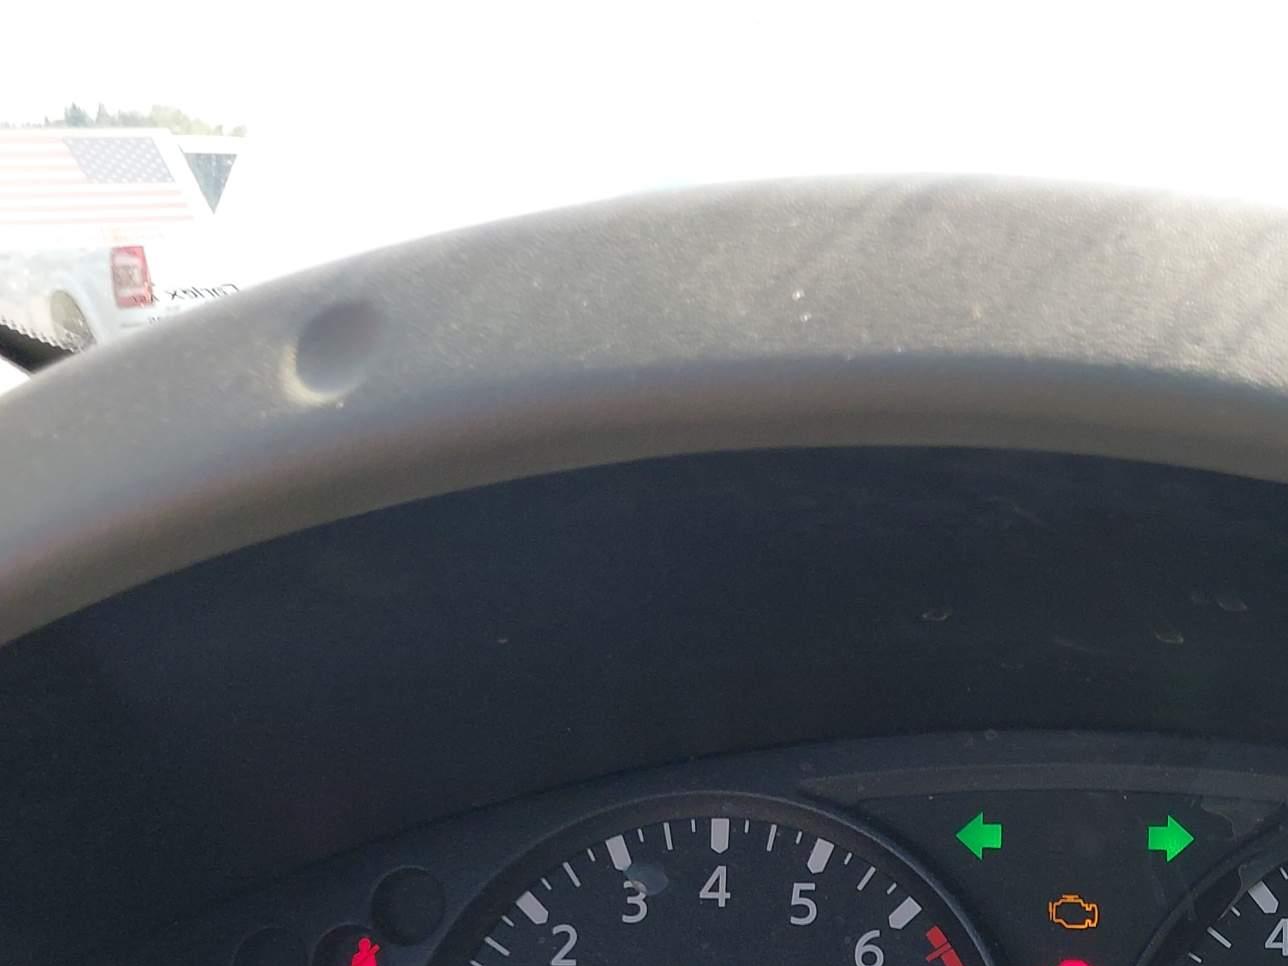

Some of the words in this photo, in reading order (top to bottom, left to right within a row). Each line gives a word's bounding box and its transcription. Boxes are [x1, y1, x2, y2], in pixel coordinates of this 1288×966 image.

[622, 879, 648, 923] 3
[699, 865, 731, 908] 4
[790, 882, 817, 926] 5
[550, 924, 578, 966] 2
